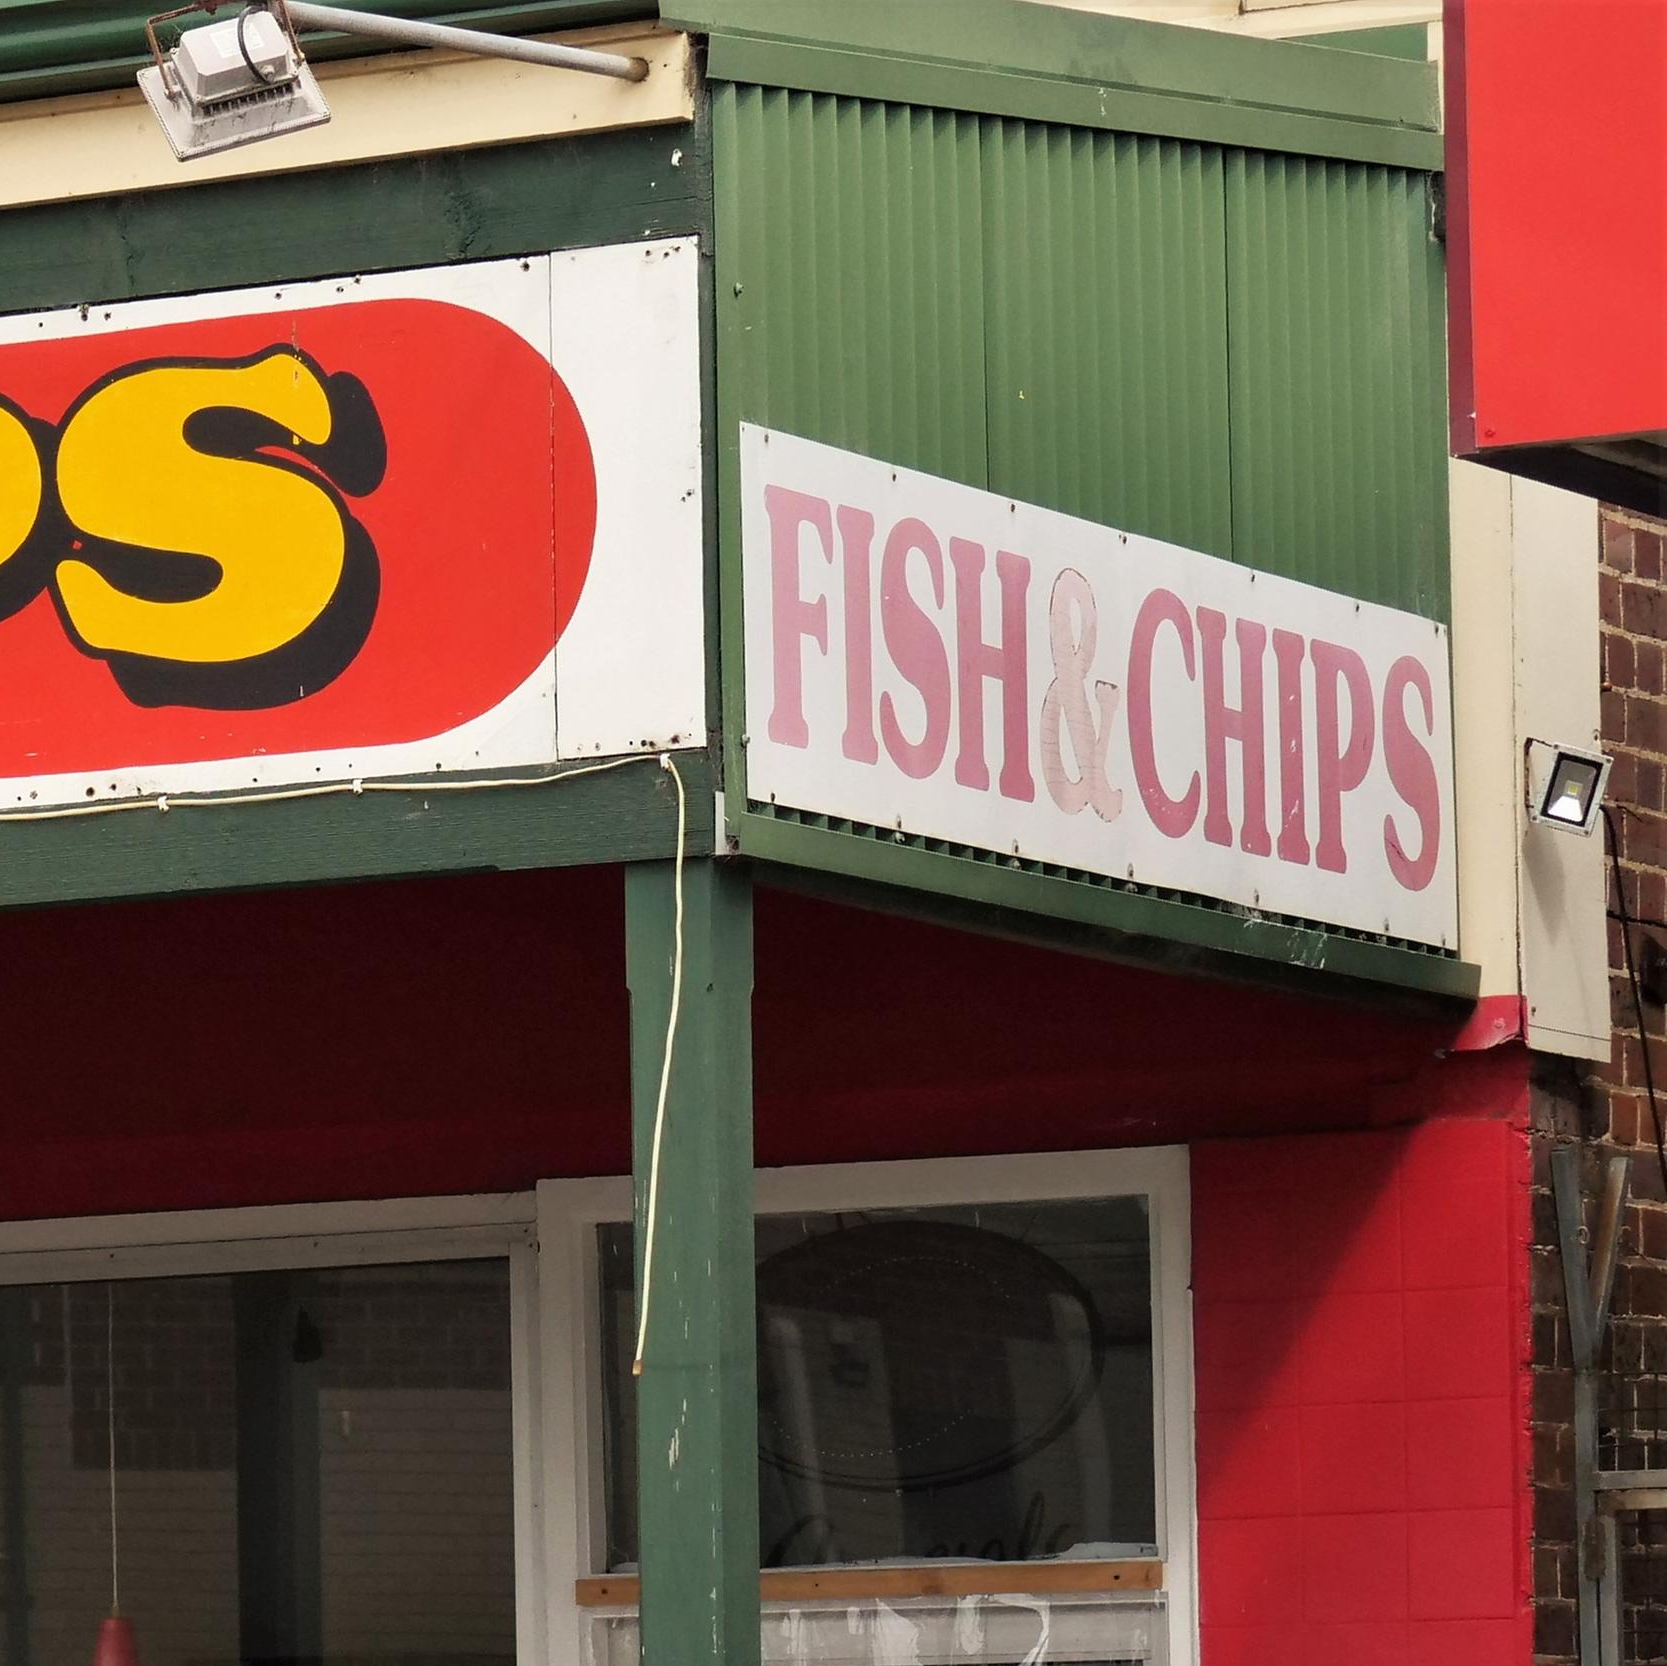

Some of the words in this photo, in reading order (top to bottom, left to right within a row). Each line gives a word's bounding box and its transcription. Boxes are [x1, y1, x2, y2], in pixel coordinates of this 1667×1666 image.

[764, 483, 1035, 803] FISH
[1040, 567, 1123, 825] &
[1126, 587, 1441, 892] CHIPS
